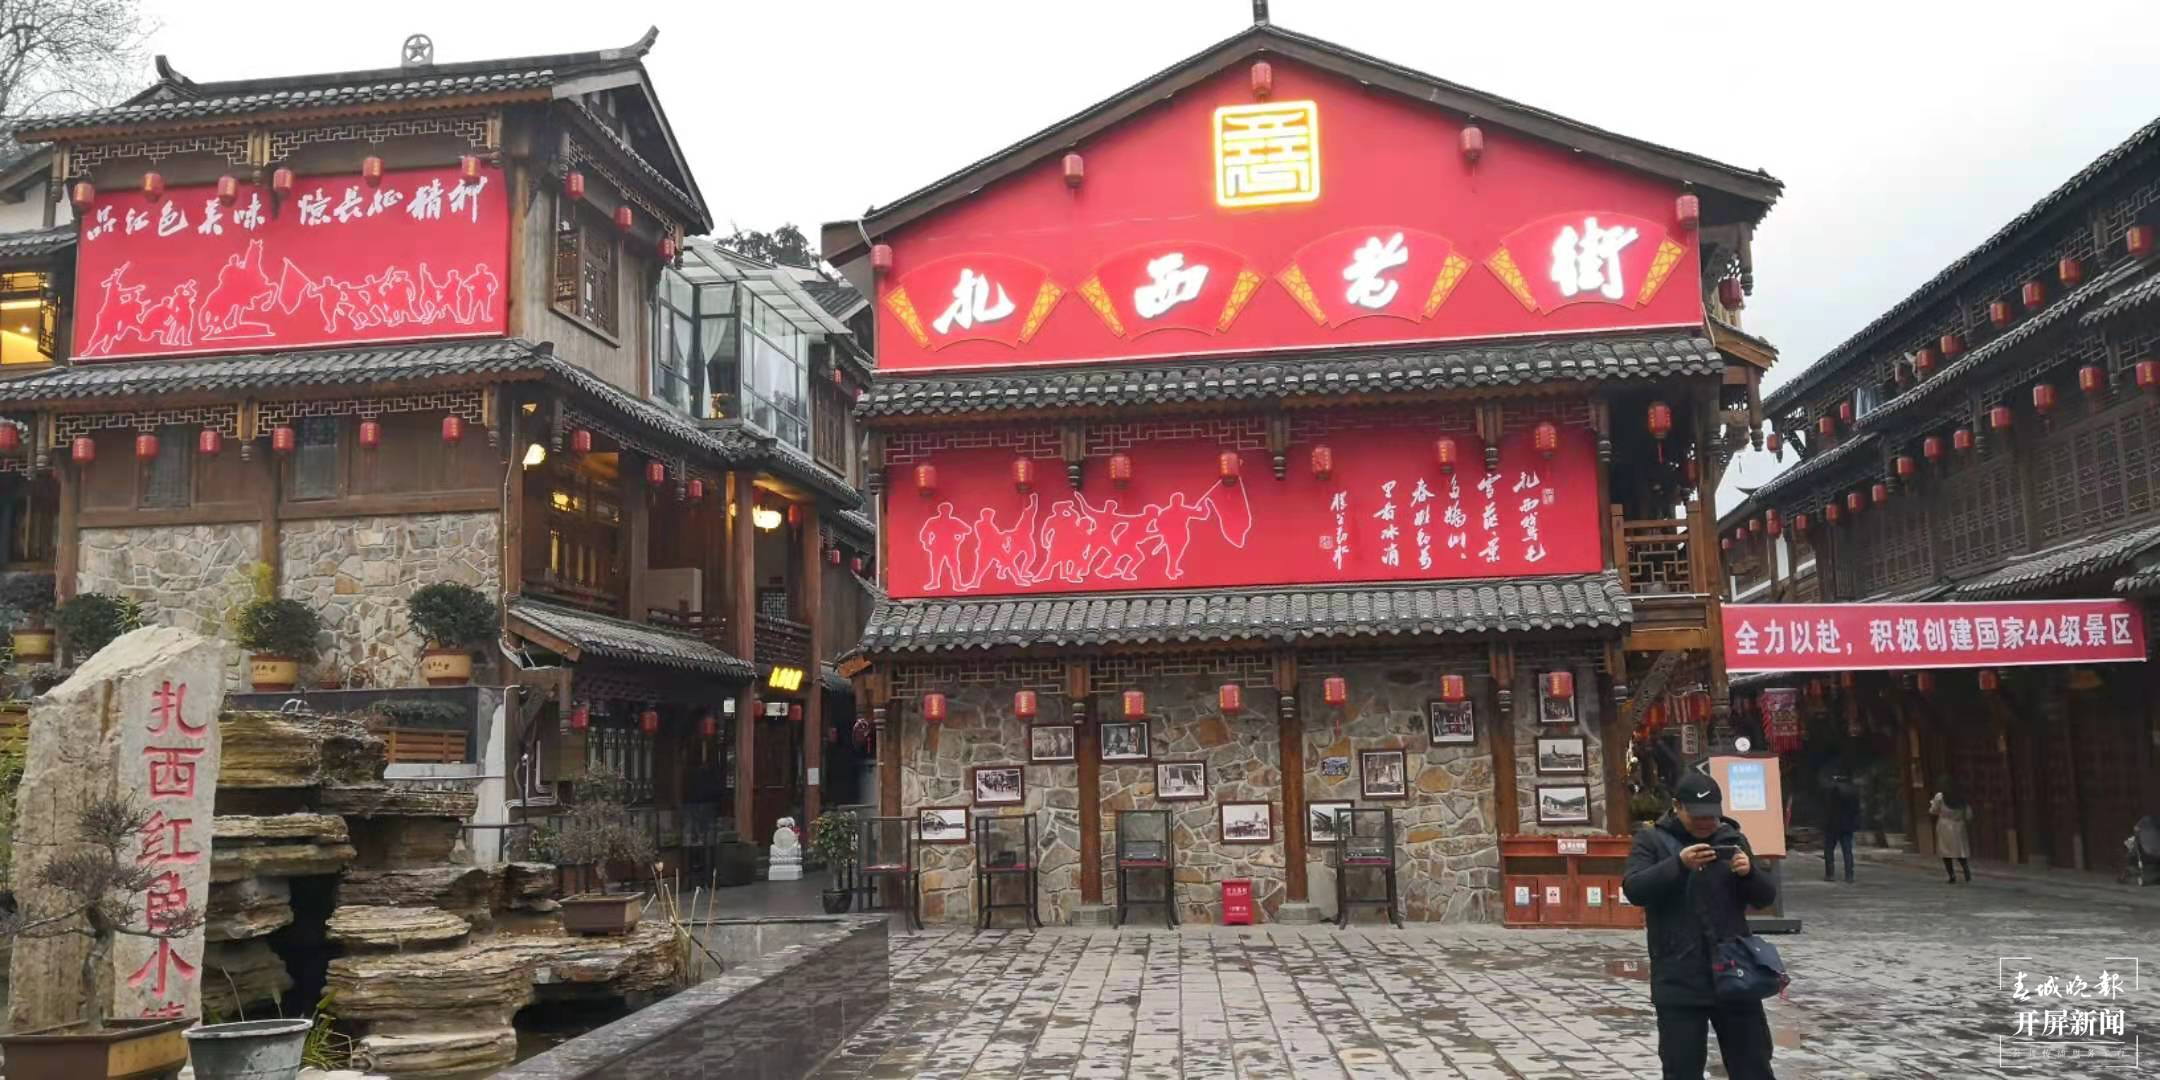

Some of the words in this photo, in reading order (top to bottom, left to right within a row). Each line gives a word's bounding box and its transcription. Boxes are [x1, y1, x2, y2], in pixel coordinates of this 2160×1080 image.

[86, 191, 266, 241] 品红色美味
[932, 216, 1640, 335] 扎西老街
[1734, 613, 2133, 655] 全力以赴，积极创建国家4A级景区
